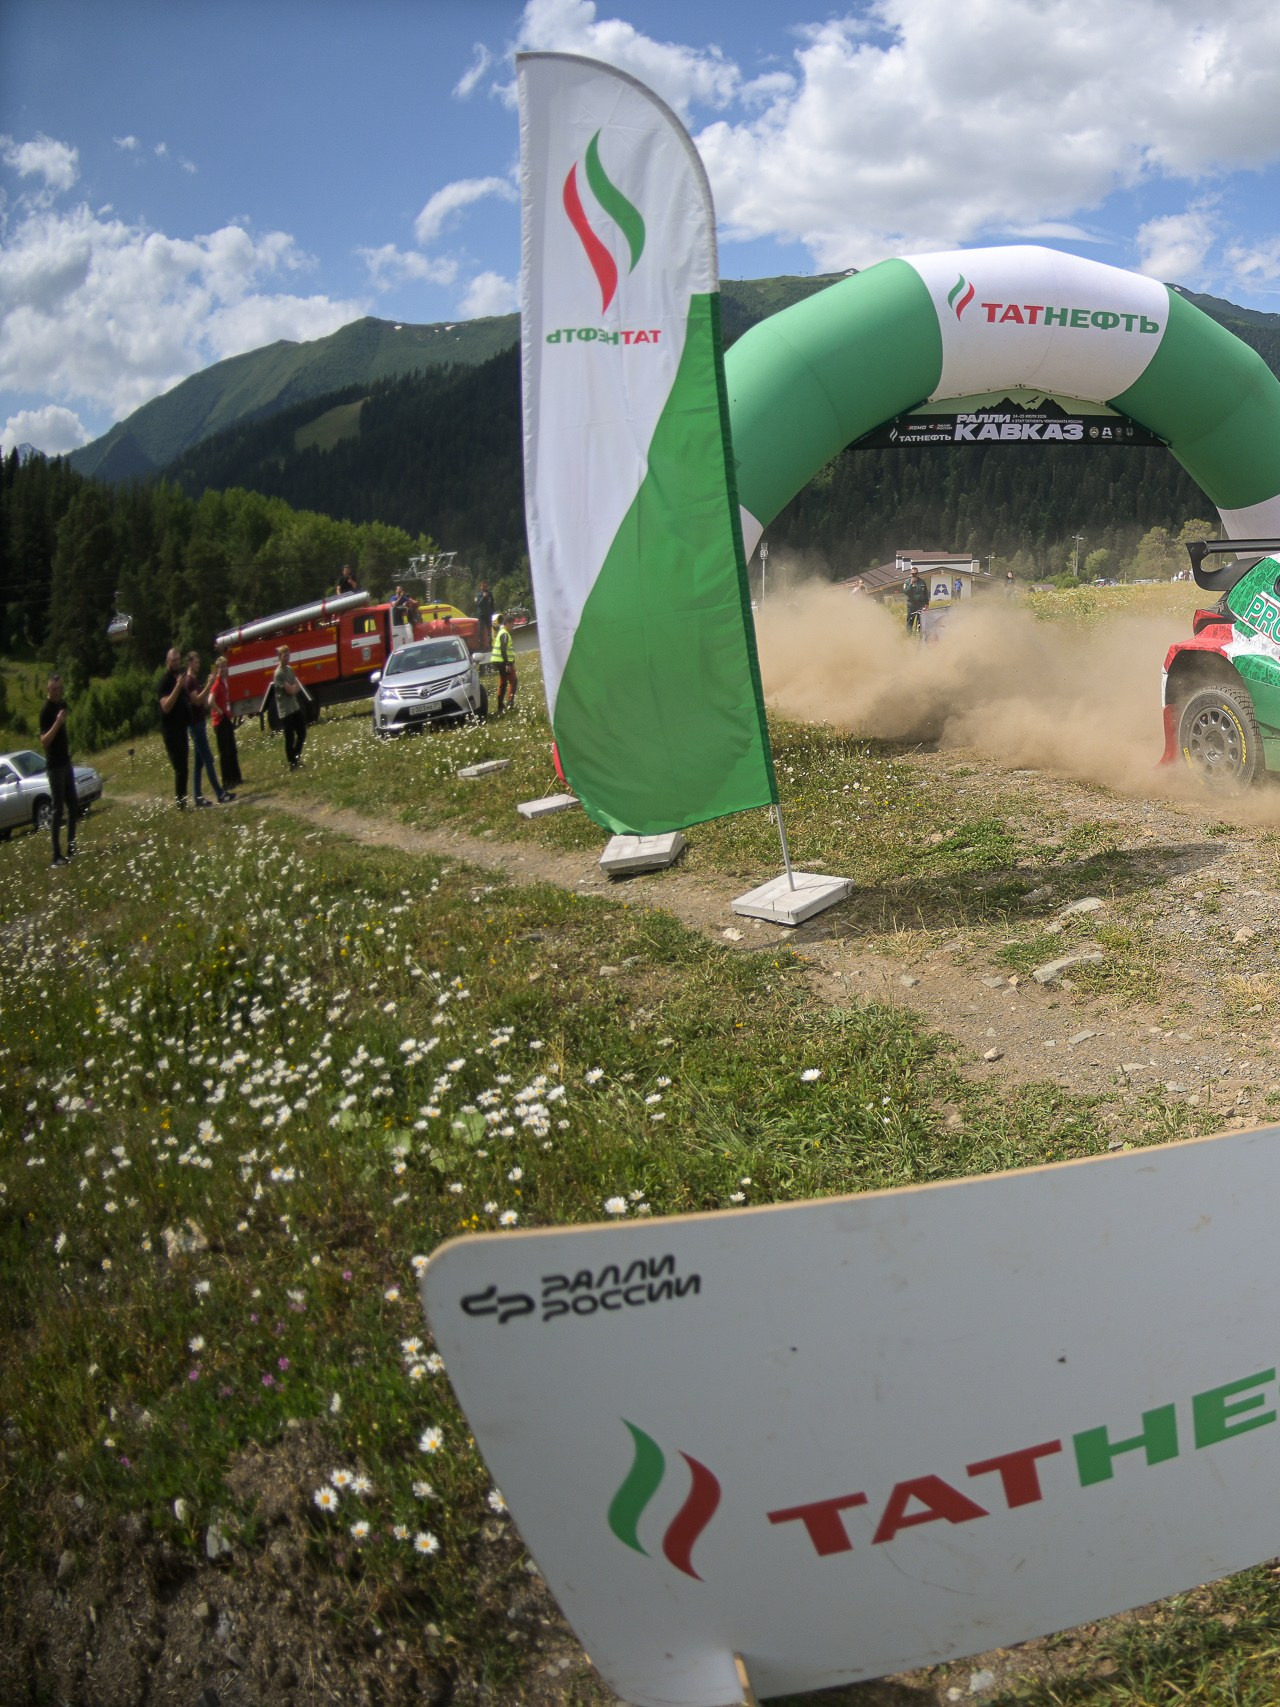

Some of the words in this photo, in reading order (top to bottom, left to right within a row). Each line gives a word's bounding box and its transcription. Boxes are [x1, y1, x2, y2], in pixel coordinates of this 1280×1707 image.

[981, 302, 1159, 335] ТАТНЕФТЬ
[956, 414, 1011, 424] РАЛЛИ
[899, 434, 952, 442] ТАТНЕФТЬ
[954, 424, 1084, 440] КАВКАЗ
[542, 1254, 676, 1297] РАЛЛИ
[542, 1274, 702, 1323] РОССИИ
